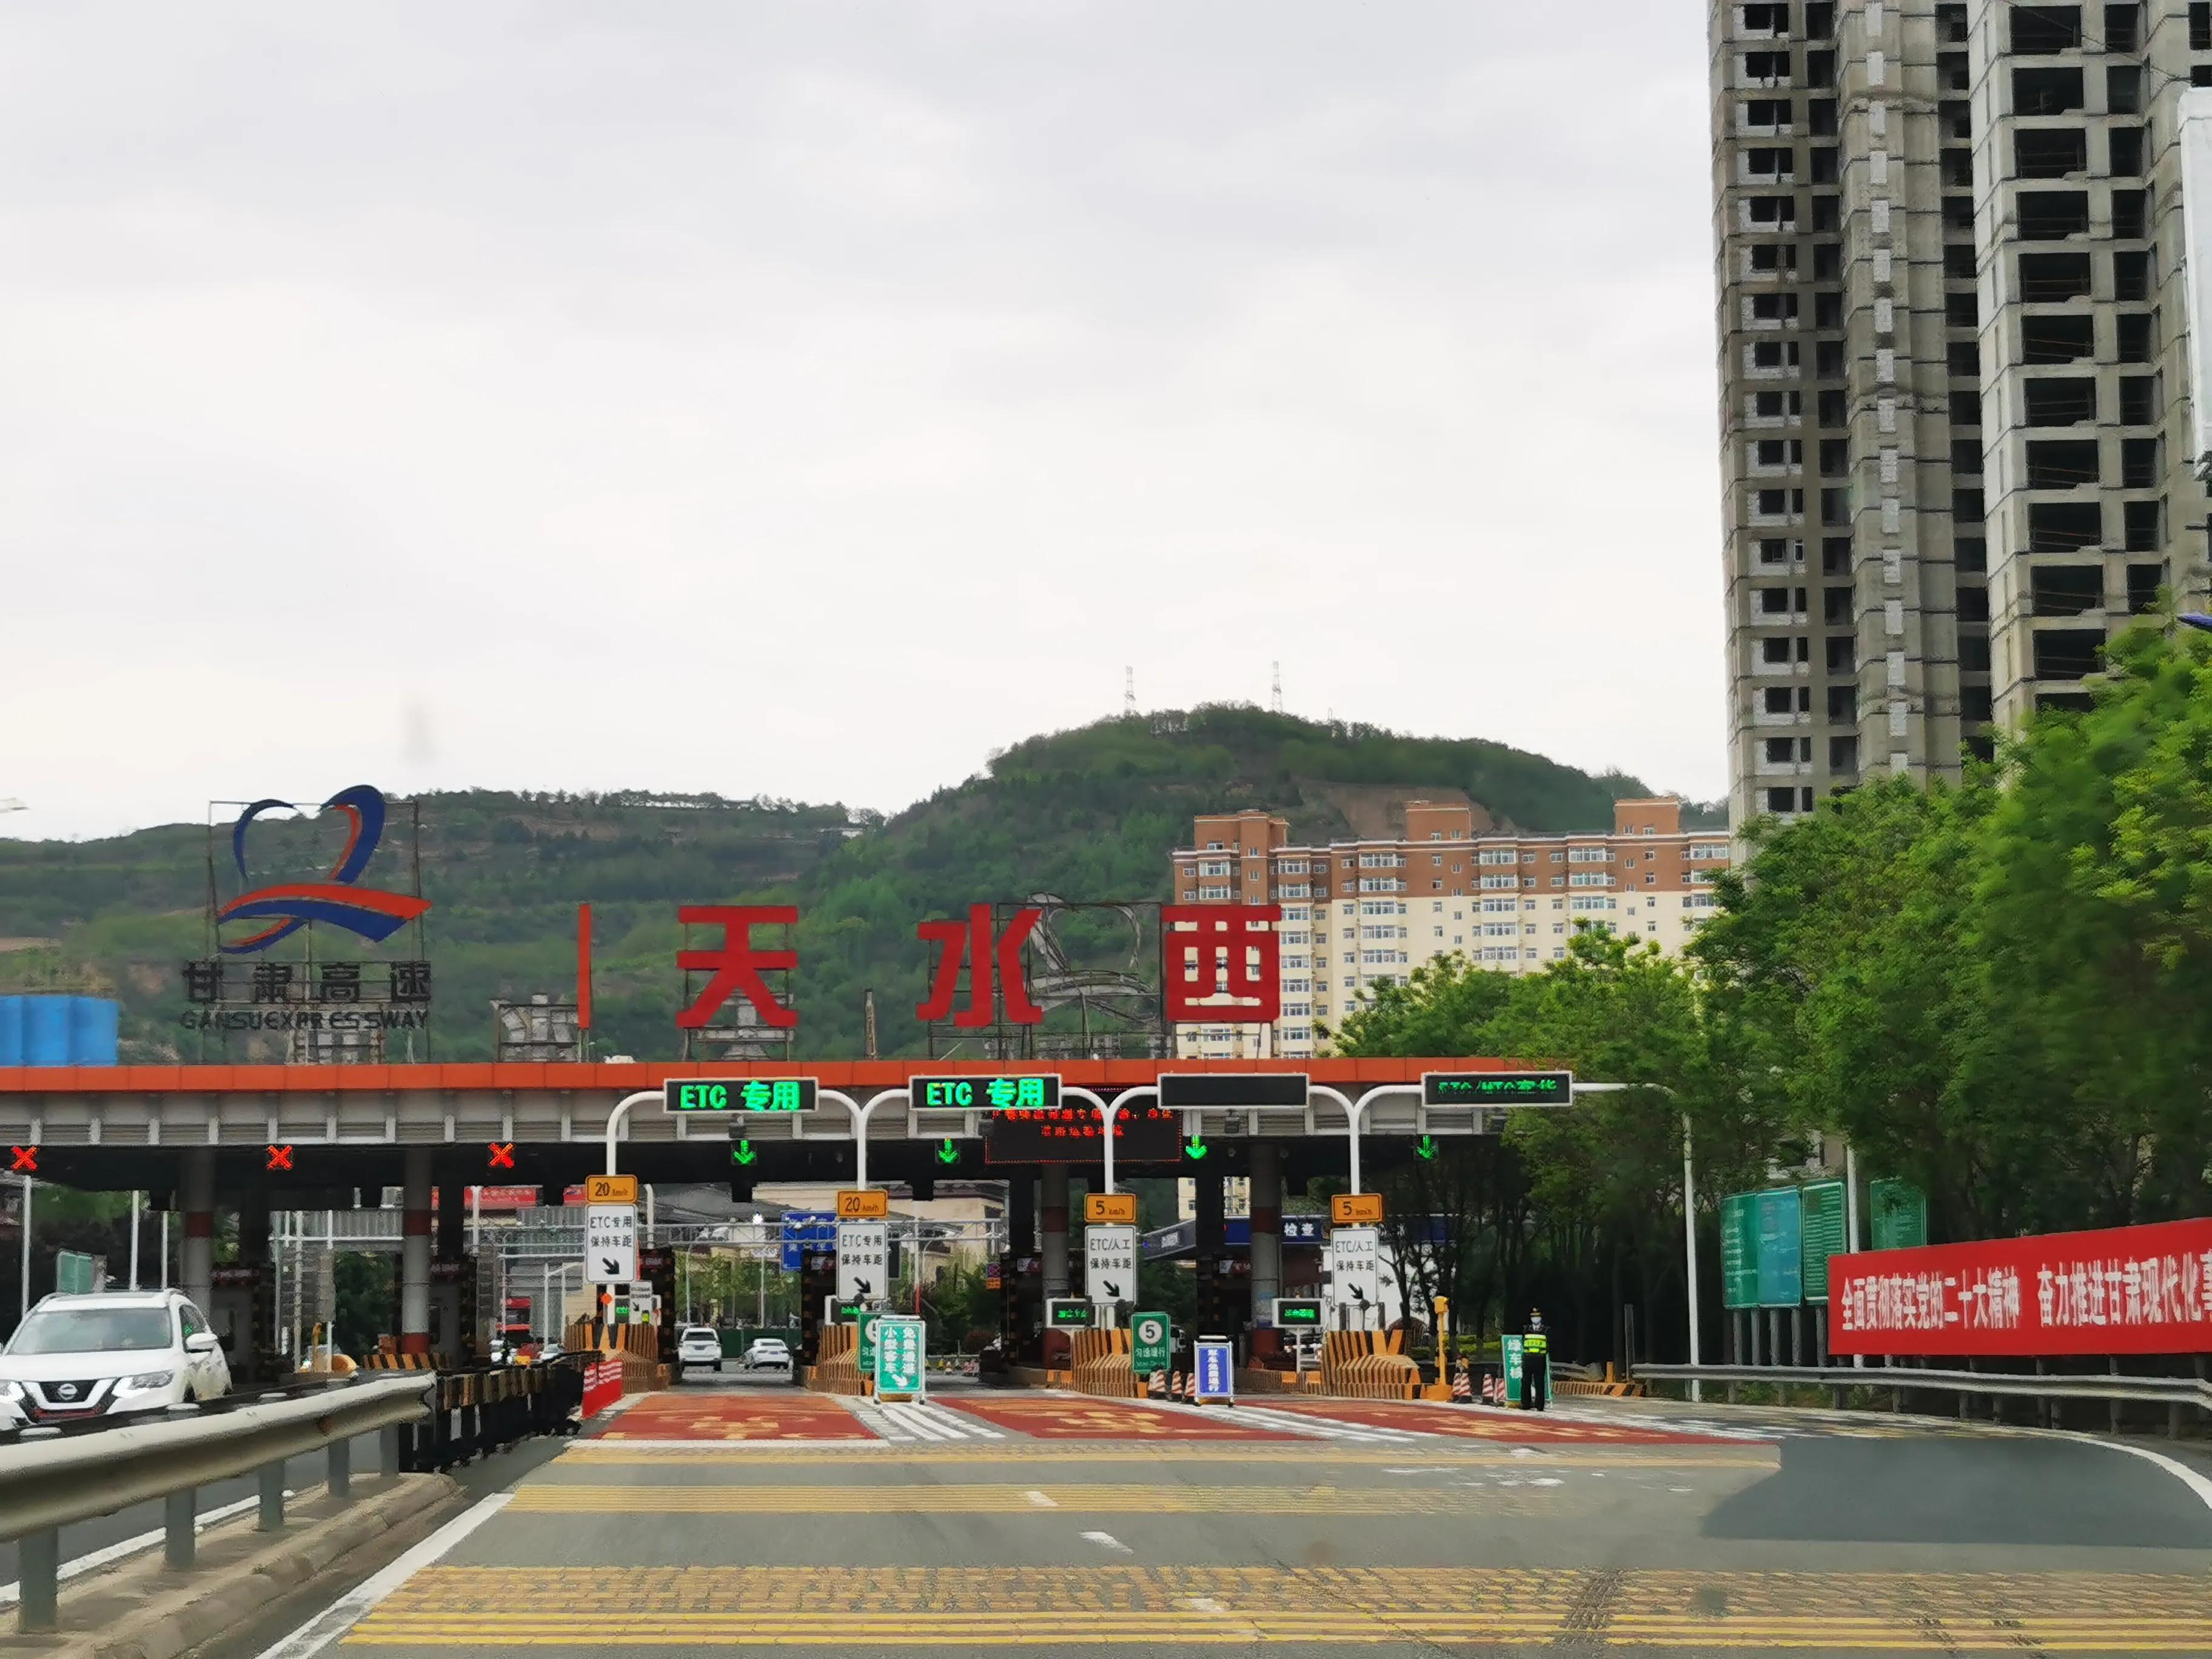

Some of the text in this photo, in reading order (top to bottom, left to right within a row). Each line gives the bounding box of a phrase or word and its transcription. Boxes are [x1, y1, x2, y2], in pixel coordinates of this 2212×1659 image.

[675, 903, 1281, 1027] 天水西
[183, 961, 431, 1004] 甘肃高速
[680, 1080, 800, 1112] ETC 专用
[927, 1078, 1044, 1108] ETC 专用
[595, 1182, 610, 1196] 20
[845, 1196, 860, 1212] 20
[1096, 1201, 1105, 1215] 5
[1342, 1201, 1352, 1216] 5
[590, 1216, 632, 1228] ETC专用
[591, 1235, 632, 1247] 保持车距
[842, 1235, 882, 1247] ETC专用
[1090, 1238, 1130, 1251] ETC/人工
[1335, 1240, 1373, 1253] ETC/人工
[841, 1254, 882, 1265] 保持车距
[1090, 1258, 1131, 1269] 保持车距
[1336, 1260, 1375, 1272] 保持车距
[1145, 1324, 1155, 1339] 5
